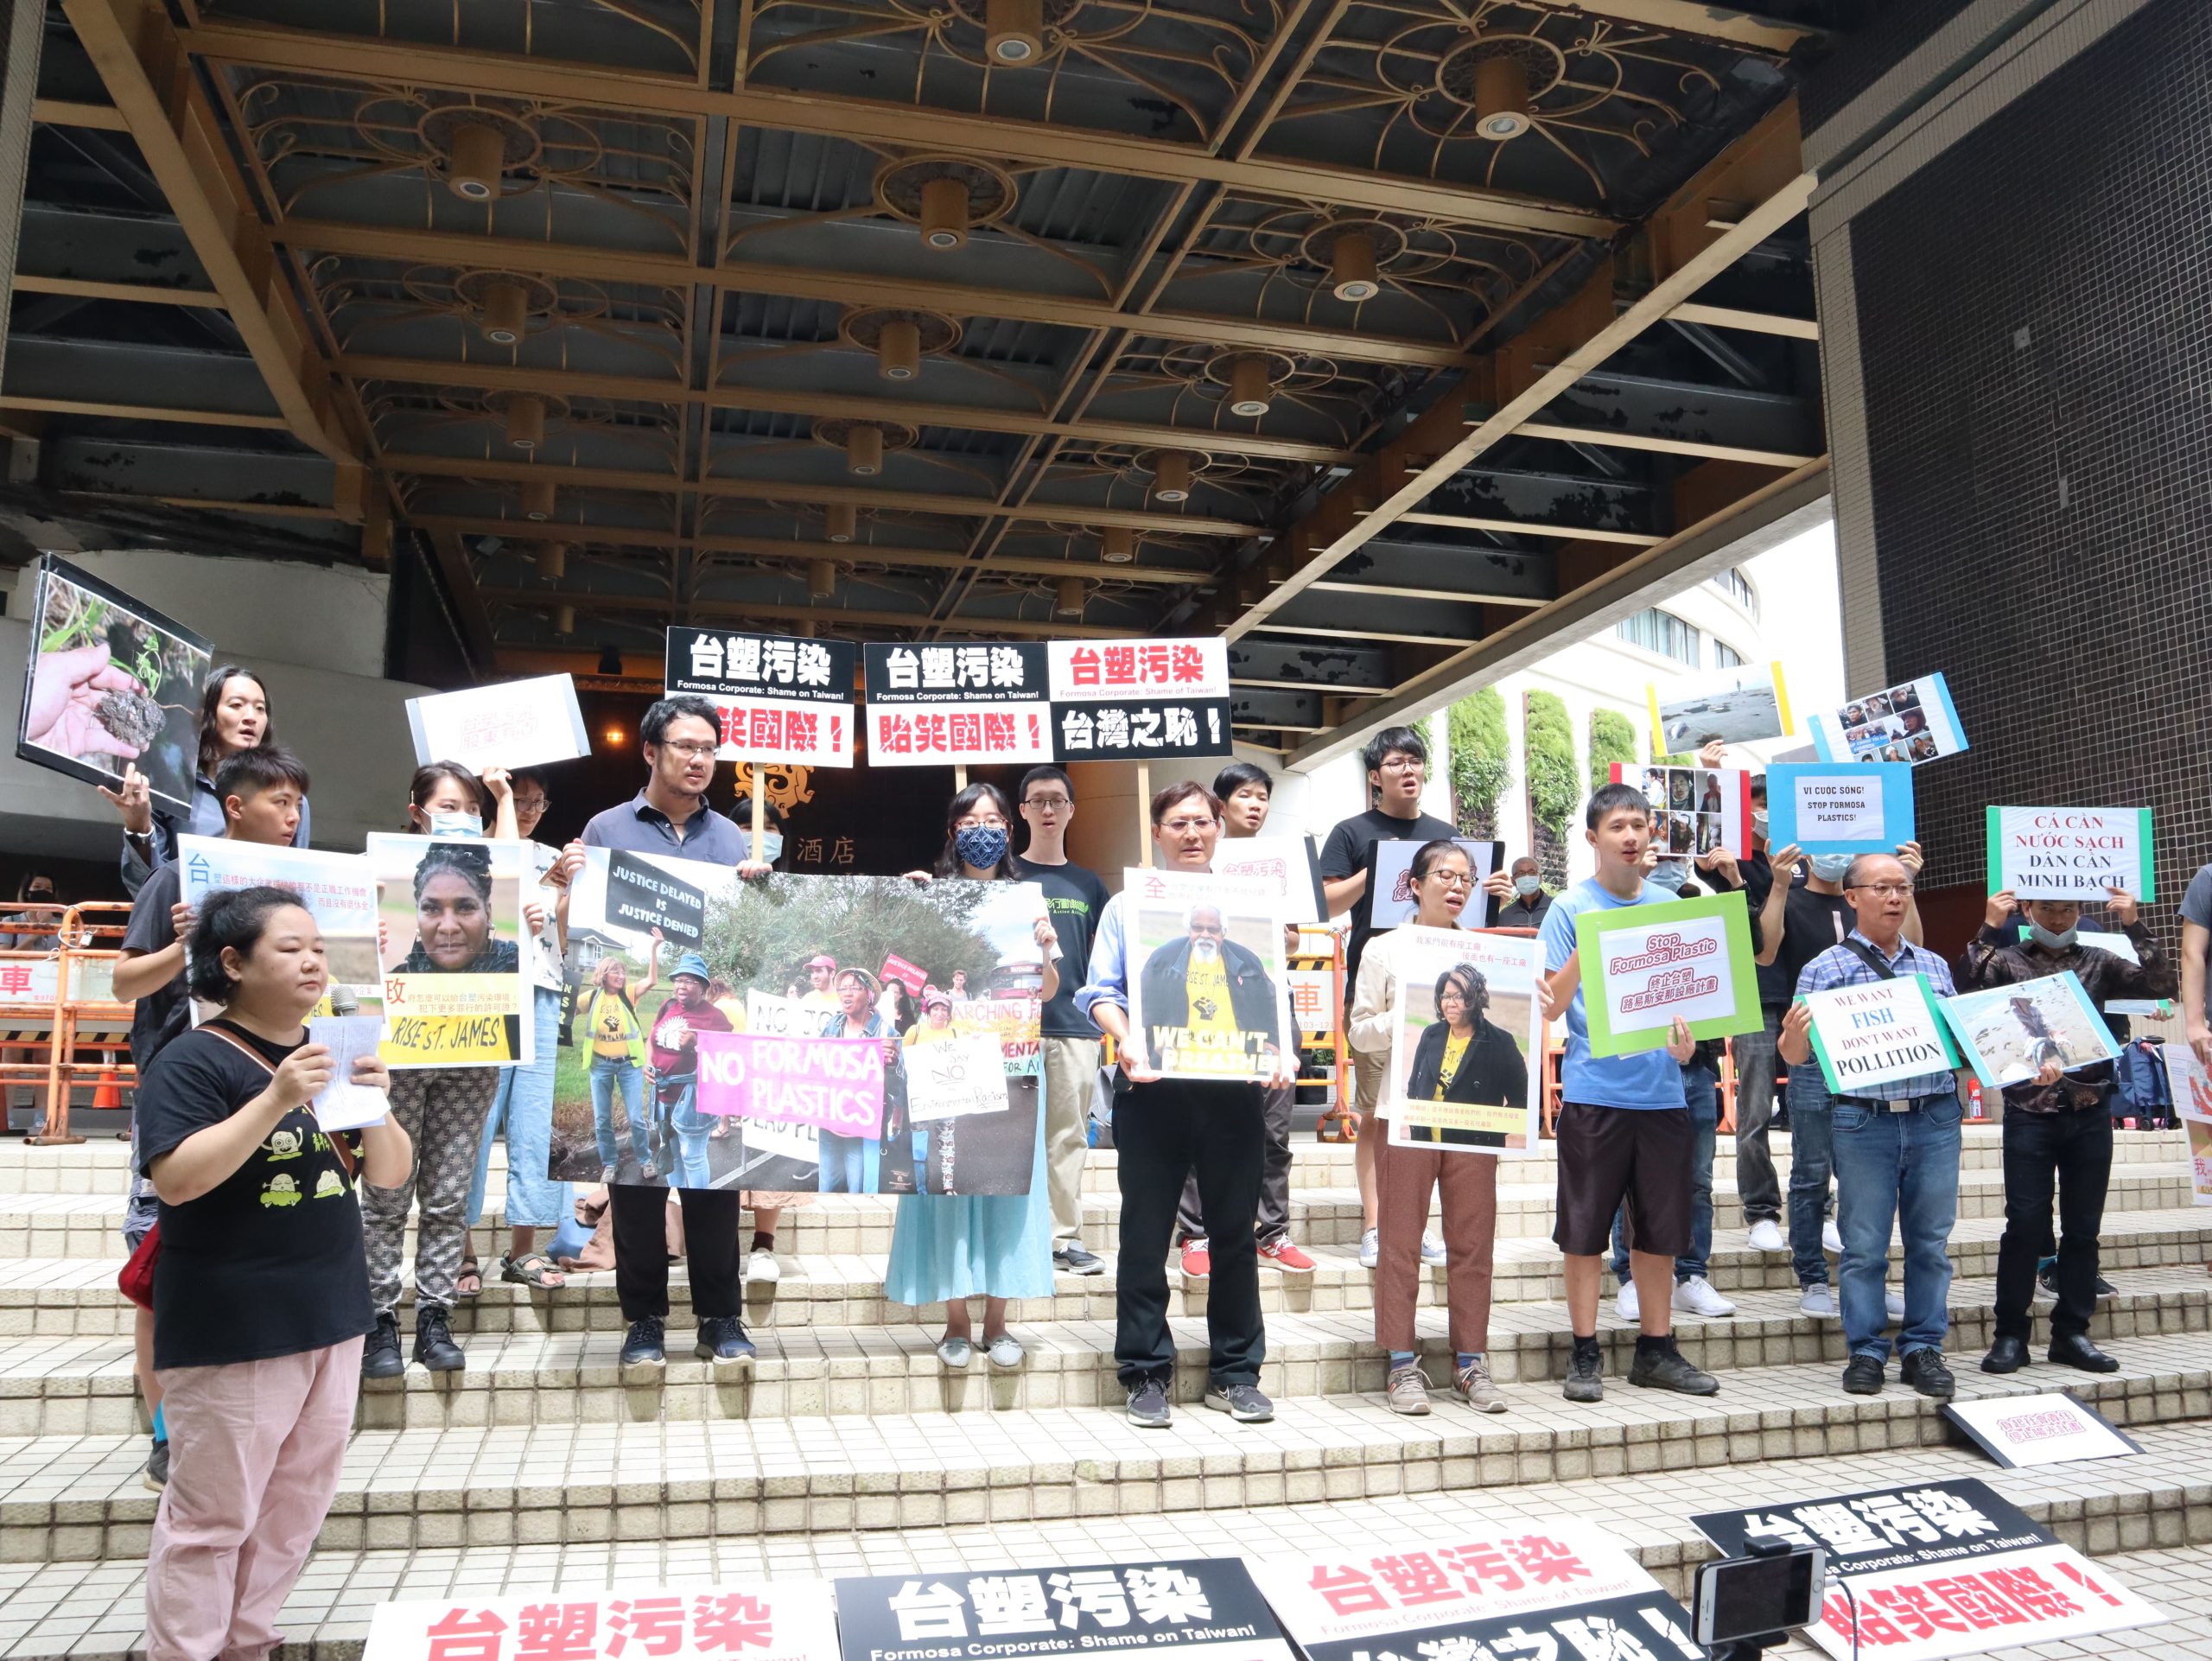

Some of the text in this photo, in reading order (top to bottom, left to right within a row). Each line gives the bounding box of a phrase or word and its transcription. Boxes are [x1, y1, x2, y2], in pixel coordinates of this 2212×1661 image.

[690, 633, 831, 686] 台塑污染
[887, 646, 1025, 689] 台塑污染
[1070, 644, 1204, 686] 台塑污染
[677, 679, 716, 691] Formosa
[719, 683, 765, 695] Corporate:
[767, 687, 797, 697] Shame
[811, 690, 844, 701] Taiwan!
[876, 692, 915, 702] Formosa
[916, 692, 962, 703] Corporate:
[963, 691, 993, 700] Shame
[1007, 690, 1039, 700] Taiwan!
[1059, 685, 1217, 698] Formosa Corporate: Shame of Taiwan!
[716, 705, 842, 753] 笑國際！
[879, 711, 1040, 754] 貽笑國際！
[1061, 707, 1221, 750] 台灣之恥！
[2035, 812, 2060, 829] CÁ
[797, 836, 855, 864] 酒店
[2016, 831, 2124, 851] NƯỚC SẠCH
[2030, 851, 2068, 868] DÂN
[613, 865, 702, 910] JUSTICE DELAYED
[1145, 876, 1166, 900] 全
[2018, 874, 2125, 891] MINH BẠCH
[619, 903, 699, 939] JUSTICE DENIED
[655, 898, 667, 912] IS
[1612, 939, 1715, 973] Formosa Plastic
[1648, 934, 1679, 950] Stop
[0, 964, 33, 995] 車
[1292, 982, 1323, 1016] 車
[1834, 988, 1894, 1008] WE WANT
[391, 1016, 427, 1048] RISE
[450, 1016, 500, 1048] JAMES
[756, 1005, 789, 1033] NO
[1851, 1007, 1895, 1029] FISH
[1881, 1026, 1919, 1042] WANT
[933, 1041, 957, 1053] WE
[1153, 1026, 1191, 1048] WE
[701, 1040, 884, 1086] NO FORMOSA
[931, 1065, 965, 1079] NO
[753, 1078, 875, 1126] PLASTICS
[1744, 1488, 1999, 1558] 台塑污染
[1841, 1550, 1920, 1573] Corporate:
[1921, 1543, 1970, 1560] Shame
[1971, 1541, 1990, 1554] on
[1990, 1533, 2044, 1551] Taiwan!
[1307, 1534, 1593, 1618] 台塑污染
[888, 1566, 1212, 1641] 台塑污染
[1320, 1617, 1400, 1637] Formosa
[1495, 1592, 1552, 1611] Shame
[1555, 1588, 1572, 1601] of
[1573, 1578, 1635, 1600] Taiwan!
[426, 1593, 774, 1661] 台塑污染
[870, 1624, 1257, 1661] Formosa Corporate: Shame on Taiwan!
